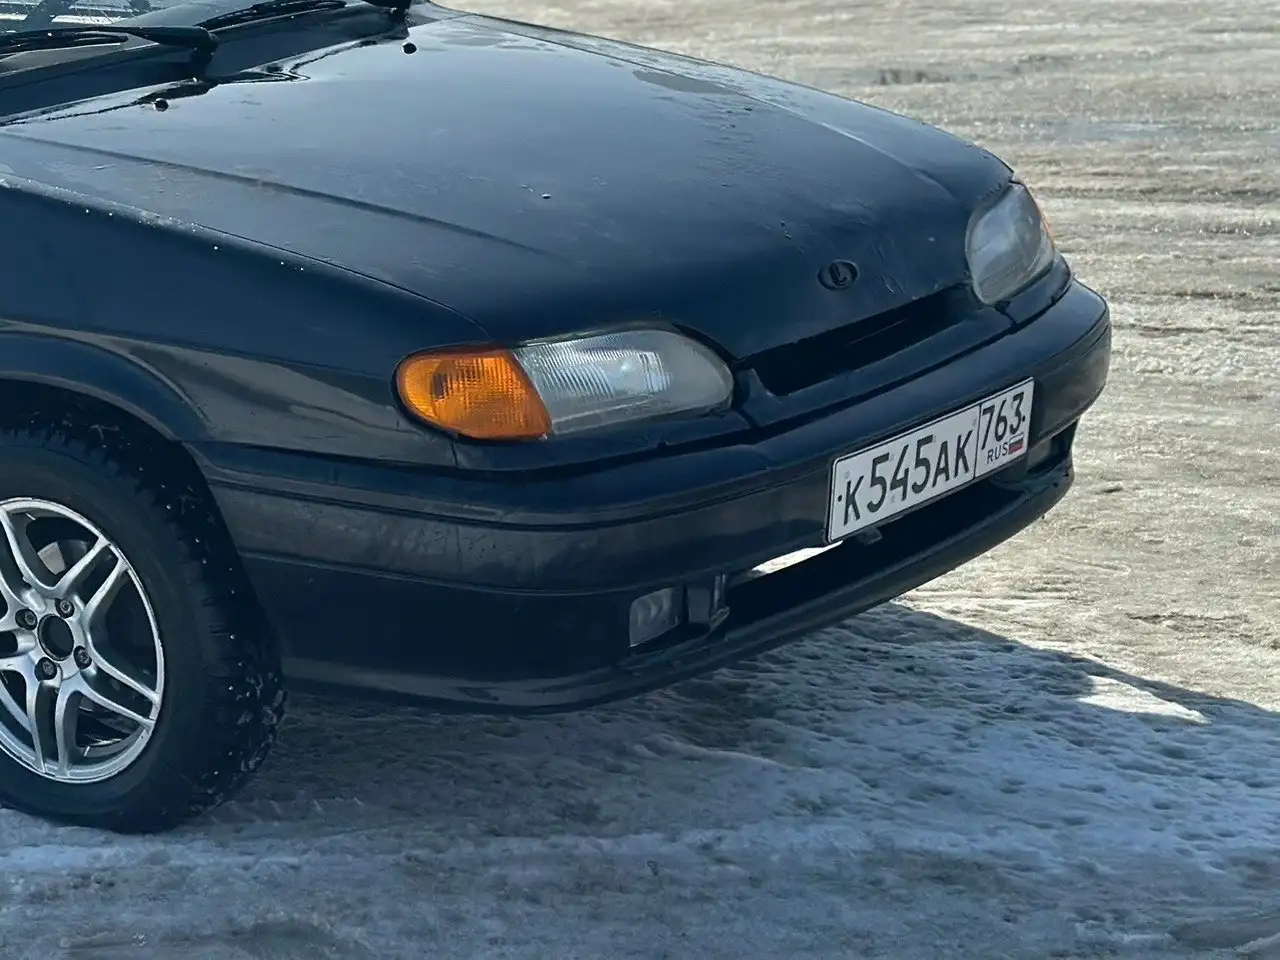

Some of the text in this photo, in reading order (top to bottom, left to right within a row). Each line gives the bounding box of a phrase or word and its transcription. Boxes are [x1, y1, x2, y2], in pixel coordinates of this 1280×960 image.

[843, 391, 1025, 526] К545АК 763
[986, 443, 1009, 464] RUS
